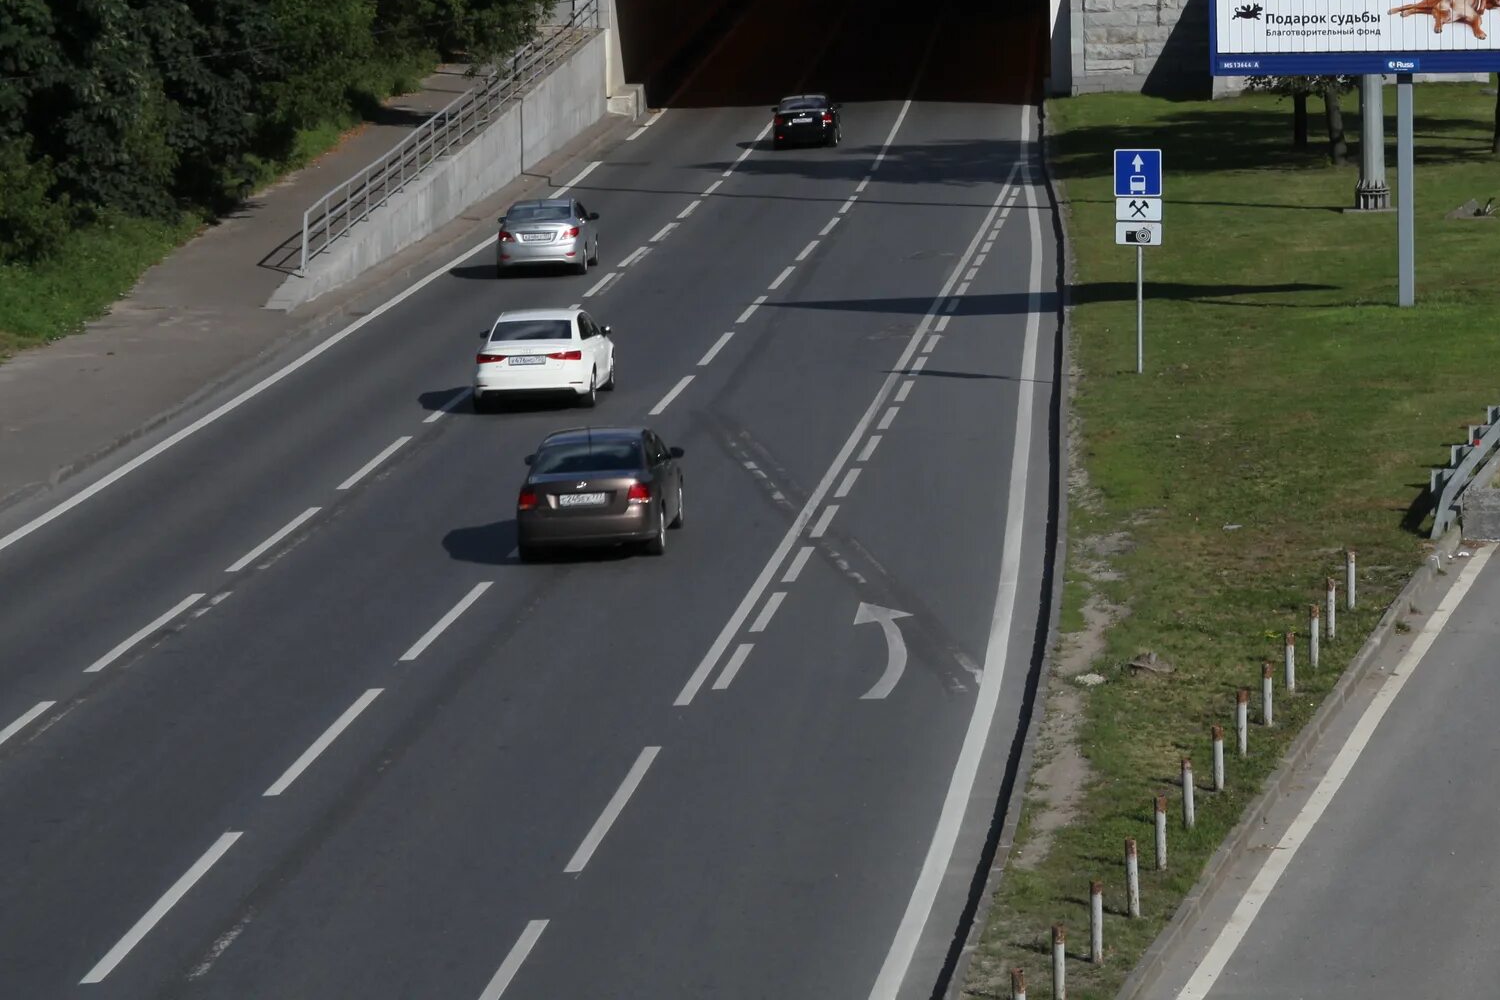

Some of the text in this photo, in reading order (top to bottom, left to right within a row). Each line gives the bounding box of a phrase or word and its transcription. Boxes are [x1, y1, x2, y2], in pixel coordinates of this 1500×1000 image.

[1266, 11, 1381, 26] Подарок судьбы
[1266, 27, 1382, 38] Благотворительный фонд
